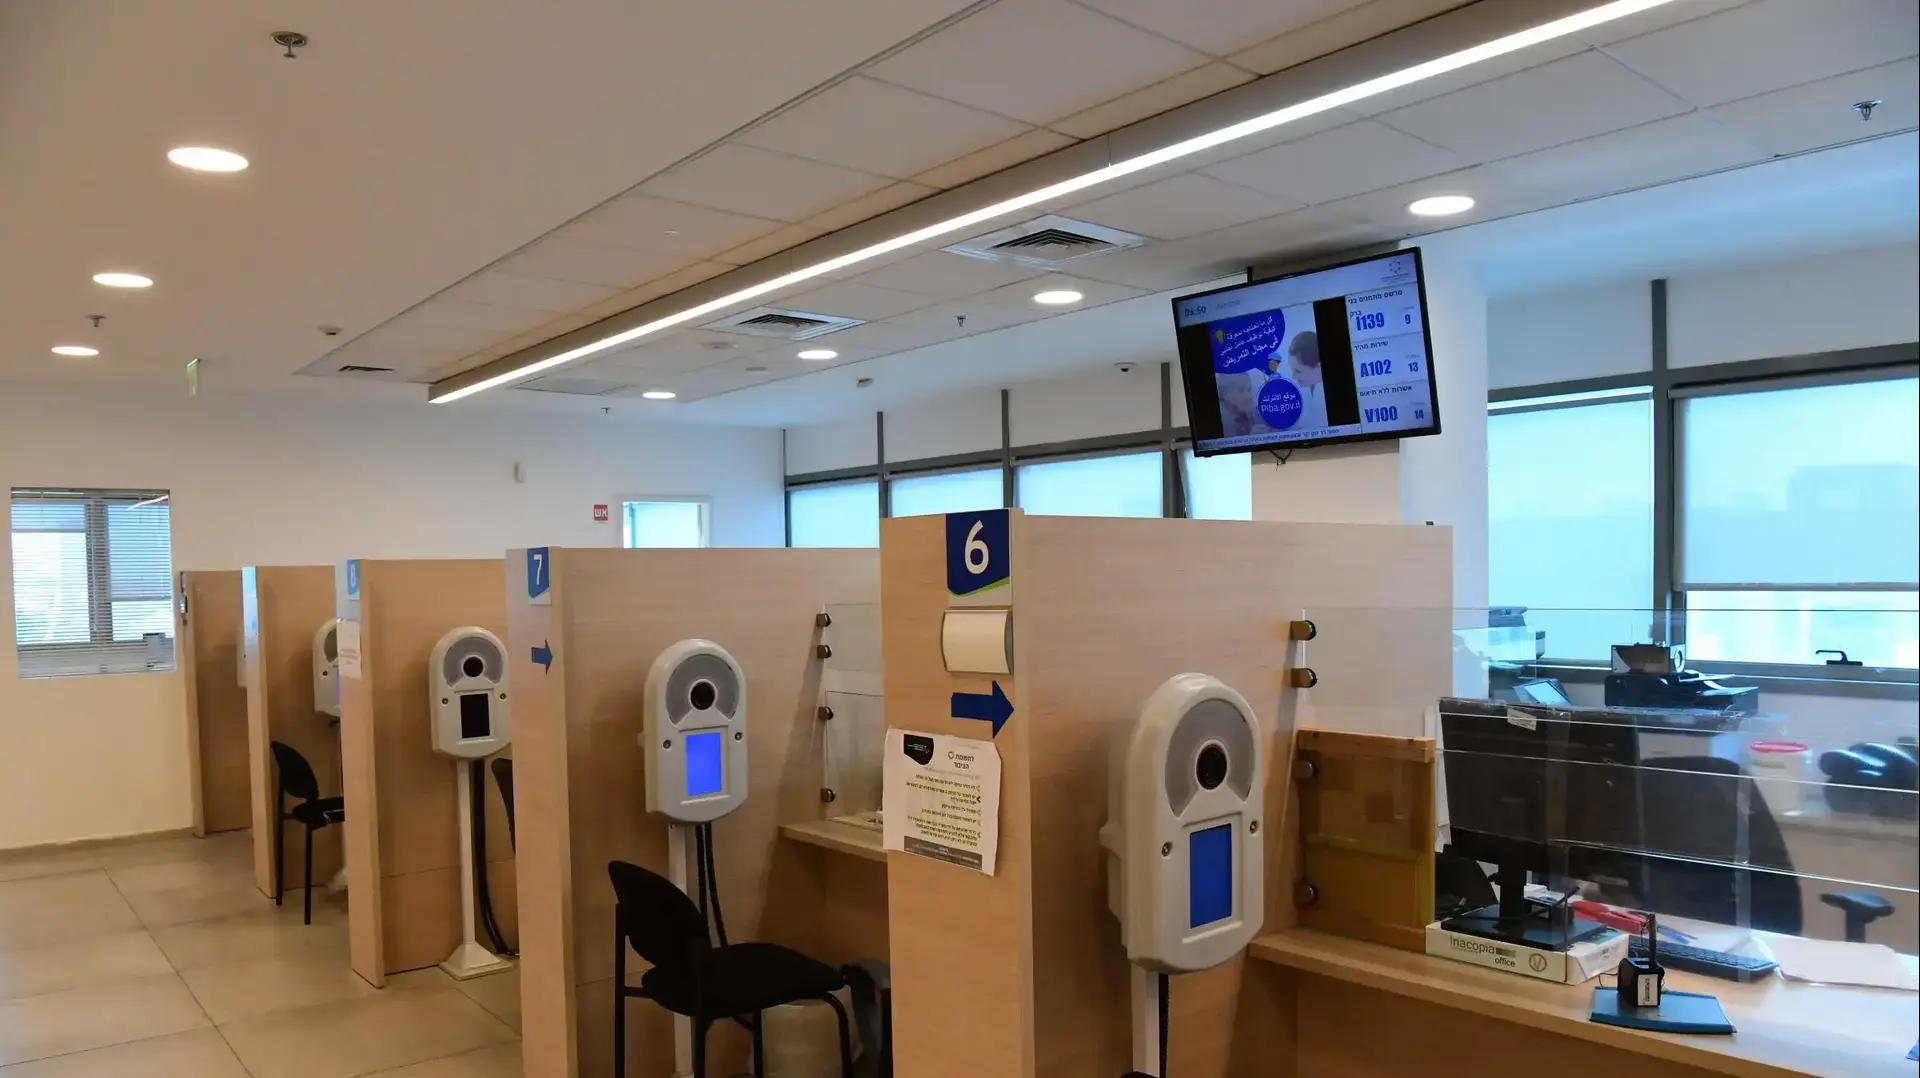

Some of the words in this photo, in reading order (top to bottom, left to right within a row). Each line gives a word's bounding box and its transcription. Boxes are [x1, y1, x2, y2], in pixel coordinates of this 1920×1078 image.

[1359, 293, 1382, 302] מוזמנים
[1384, 290, 1402, 298] מרשם
[1405, 314, 1411, 324] 9
[1370, 341, 1388, 349] שירות
[1360, 359, 1392, 378] A102
[1408, 362, 1418, 372] 13
[1283, 392, 1296, 402] موقع
[1261, 400, 1300, 413] Piba.gov.il
[1365, 406, 1398, 423] V100
[1414, 409, 1424, 419] 14
[595, 509, 608, 518] אש
[965, 520, 989, 574] 6
[534, 554, 542, 585] 7
[350, 564, 357, 588] 8
[1450, 935, 1495, 954] Inacopia
[1495, 957, 1516, 967] office
